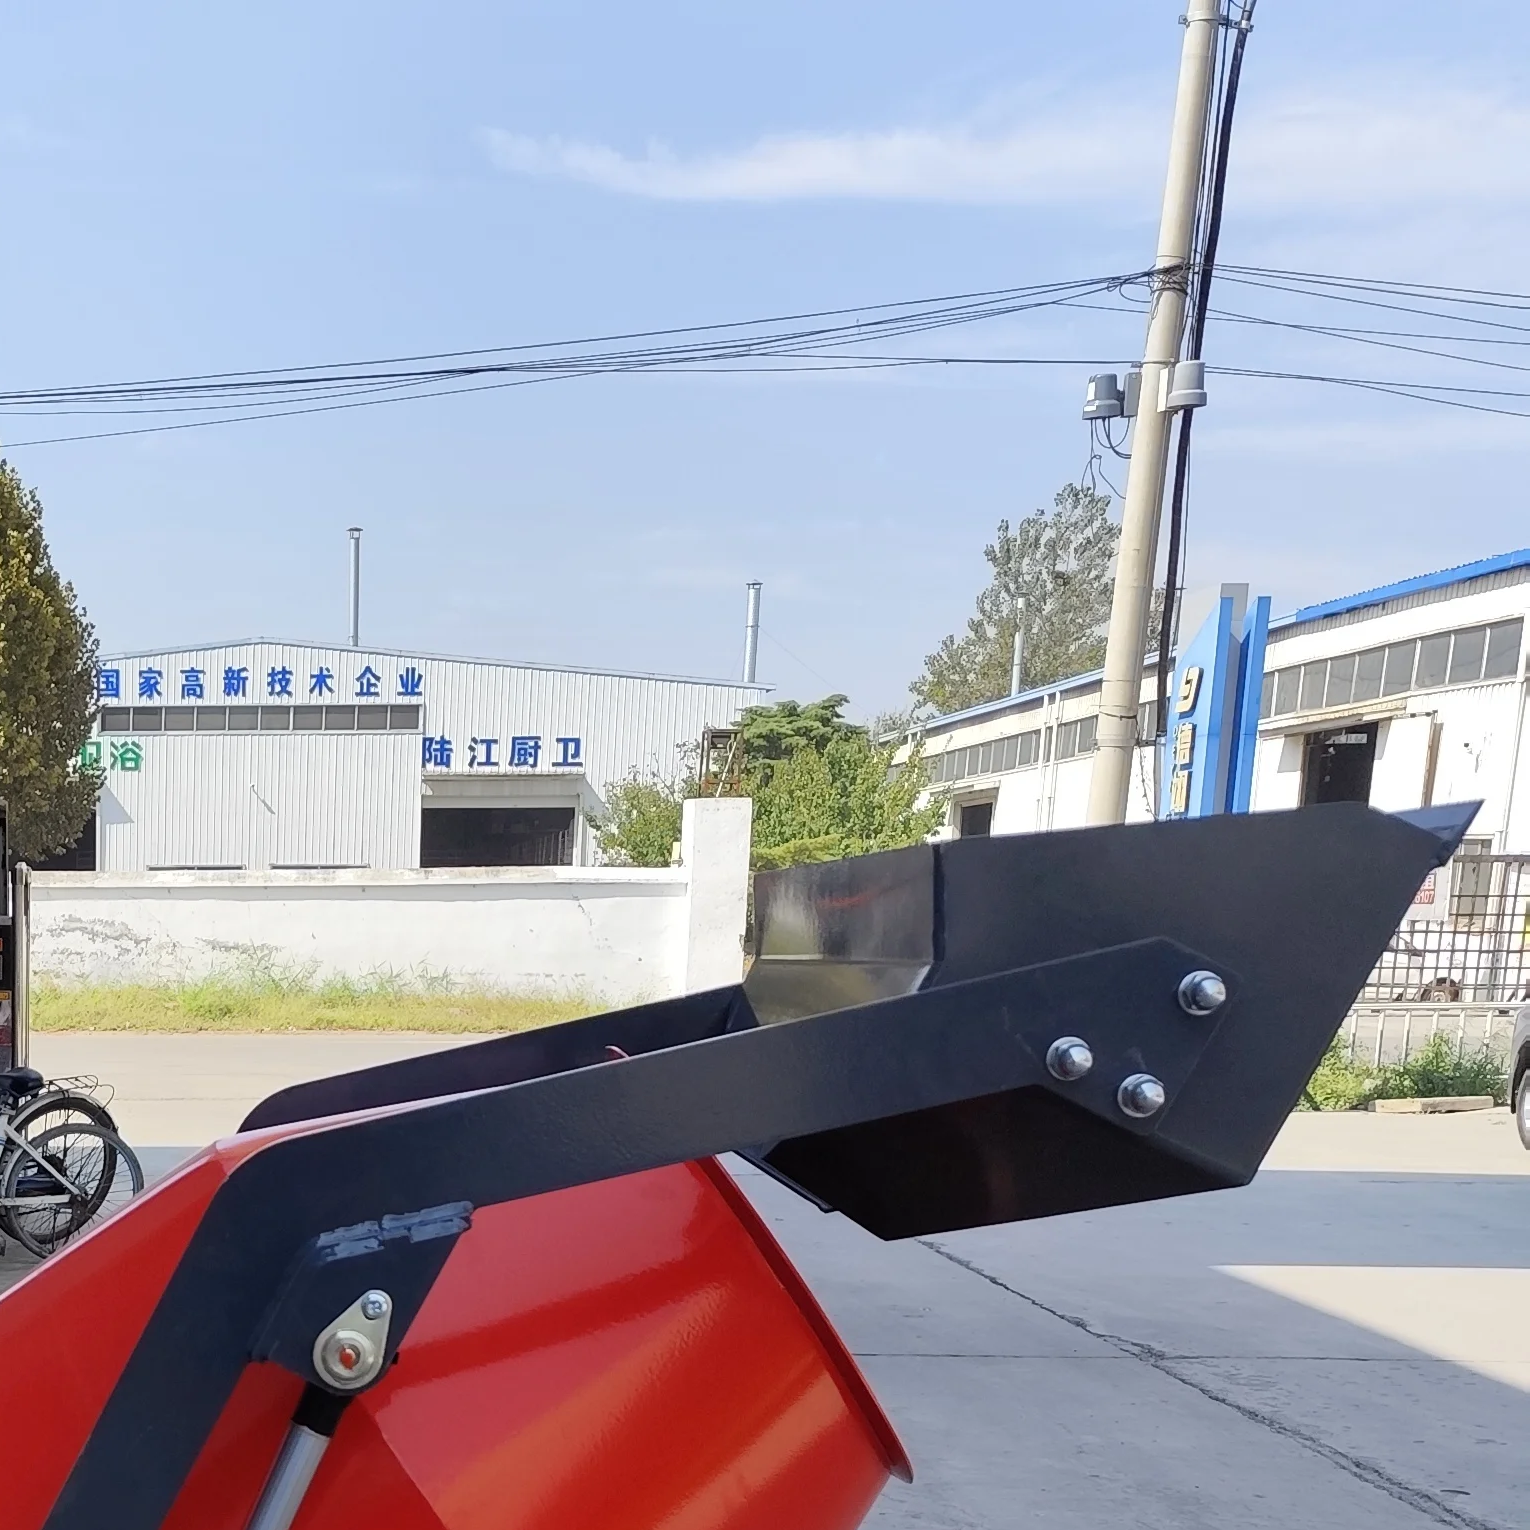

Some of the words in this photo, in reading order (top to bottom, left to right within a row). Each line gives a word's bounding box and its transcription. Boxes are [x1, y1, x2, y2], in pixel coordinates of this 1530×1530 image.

[97, 665, 425, 700] 国家高新技术企业
[421, 735, 584, 770] 陆江厨卫
